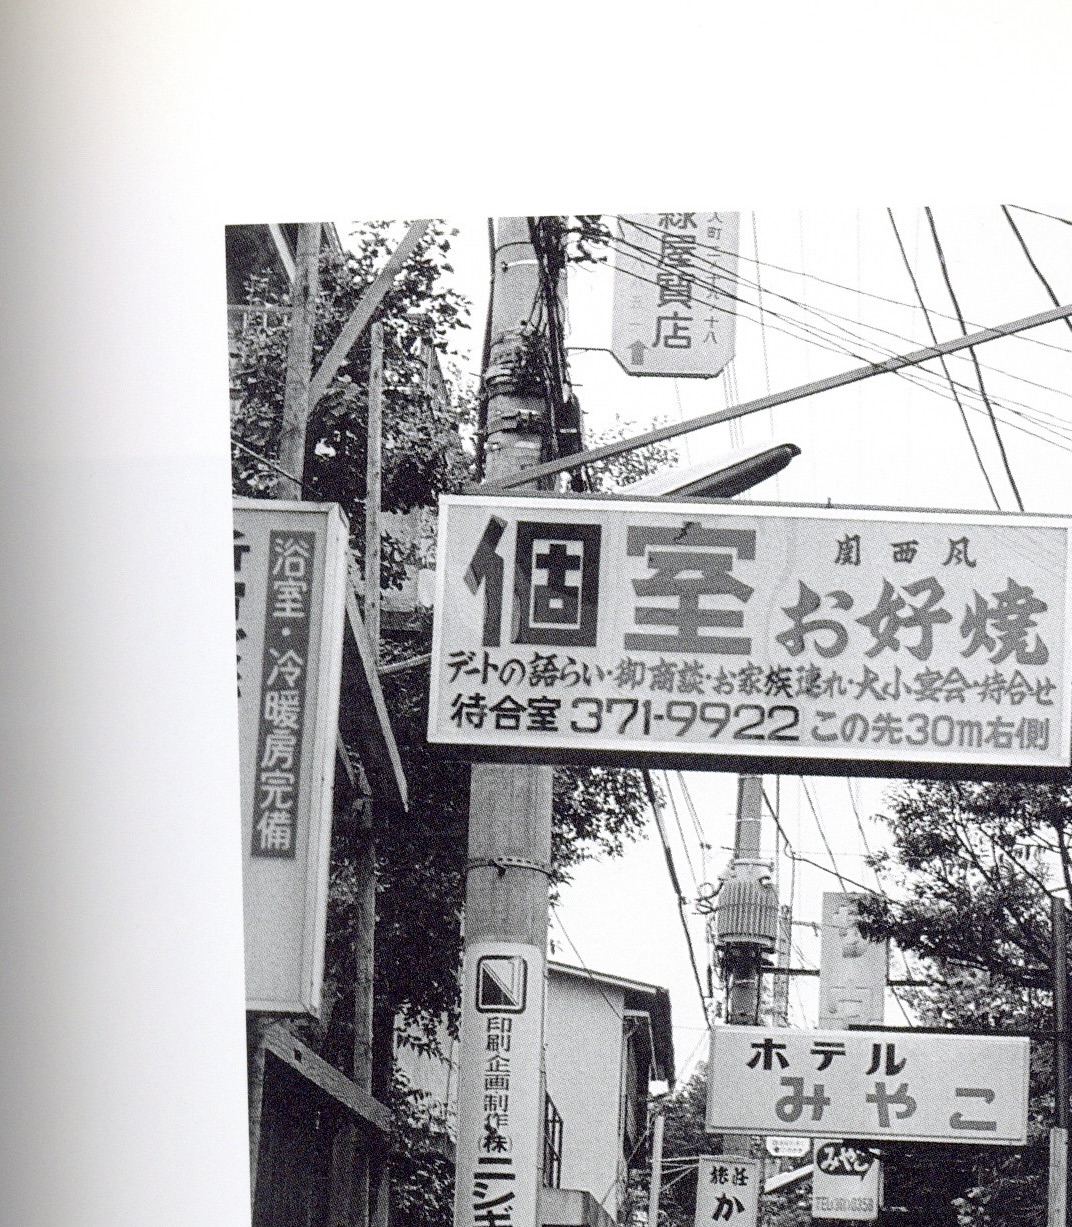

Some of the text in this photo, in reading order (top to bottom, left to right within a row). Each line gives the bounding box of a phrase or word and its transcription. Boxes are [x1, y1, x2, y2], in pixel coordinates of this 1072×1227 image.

[463, 515, 758, 656] 個室
[775, 575, 1049, 666] お好焼
[256, 537, 310, 850] 浴室・冷暖房完備
[450, 693, 1050, 750] 待合室 371-9922 この先30m右側
[746, 1038, 907, 1076] ホテル
[775, 1076, 998, 1132] みやこ
[821, 1147, 870, 1172] みやこ
